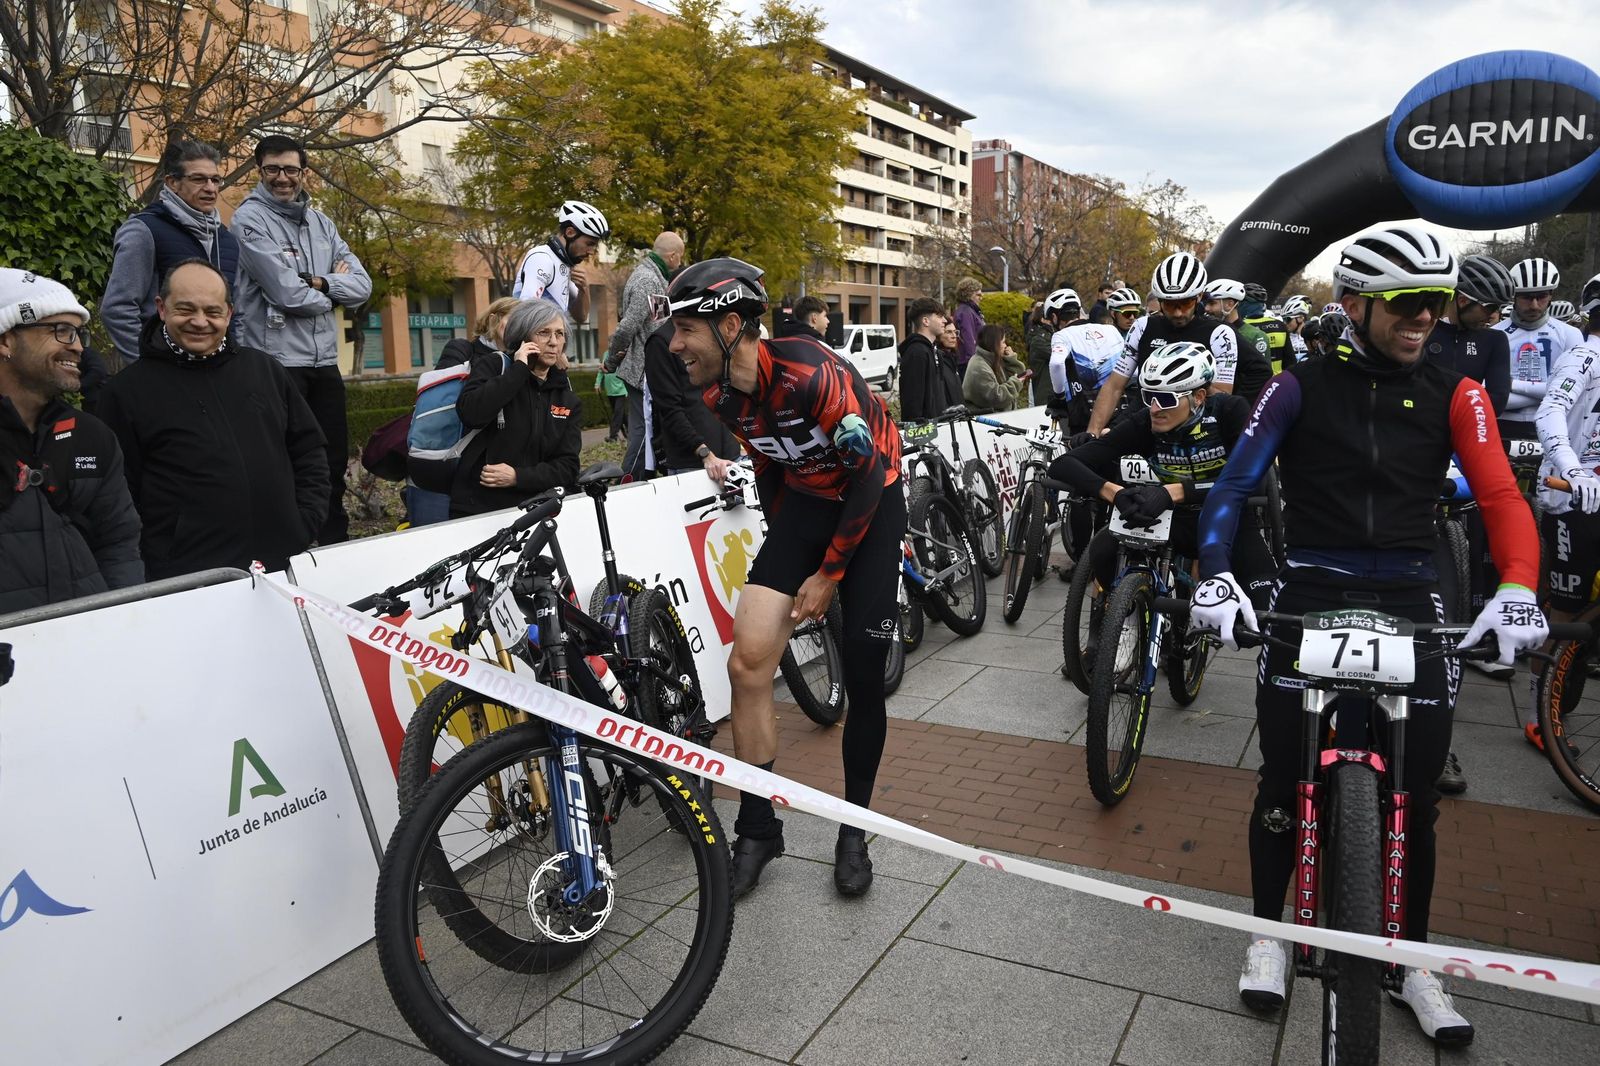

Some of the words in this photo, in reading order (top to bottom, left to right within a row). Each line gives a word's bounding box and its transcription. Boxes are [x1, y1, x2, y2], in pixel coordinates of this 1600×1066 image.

[1407, 114, 1587, 151] GARMIN
[1240, 219, 1311, 236] garmin.com
[1341, 273, 1369, 289] GIST
[1253, 381, 1280, 420] KENDA
[748, 424, 830, 461] BH
[907, 423, 935, 437] STAFF
[1033, 428, 1057, 444] 13-2
[1474, 405, 1488, 443] KENDA
[1518, 441, 1541, 456] 69-
[1557, 519, 1572, 562] KTM
[424, 574, 455, 609] 9-2
[1550, 571, 1582, 593] SLP
[495, 599, 518, 638] 9-1
[536, 606, 556, 618] BH
[667, 605, 685, 637] MAXXIS
[1498, 604, 1543, 618] FAST
[1501, 614, 1544, 628] RIDE
[370, 625, 470, 677] octagon
[1330, 632, 1381, 672] 7-1
[1336, 670, 1346, 678] DE
[1348, 671, 1376, 680] COSMO
[1550, 640, 1582, 737] SPADABIK
[198, 824, 241, 856] Junta
[243, 818, 261, 834] de
[263, 787, 328, 827] Andalucía
[667, 775, 716, 845] MAXXIS
[1299, 819, 1319, 920] MANITO
[1386, 830, 1406, 933] MANITO
